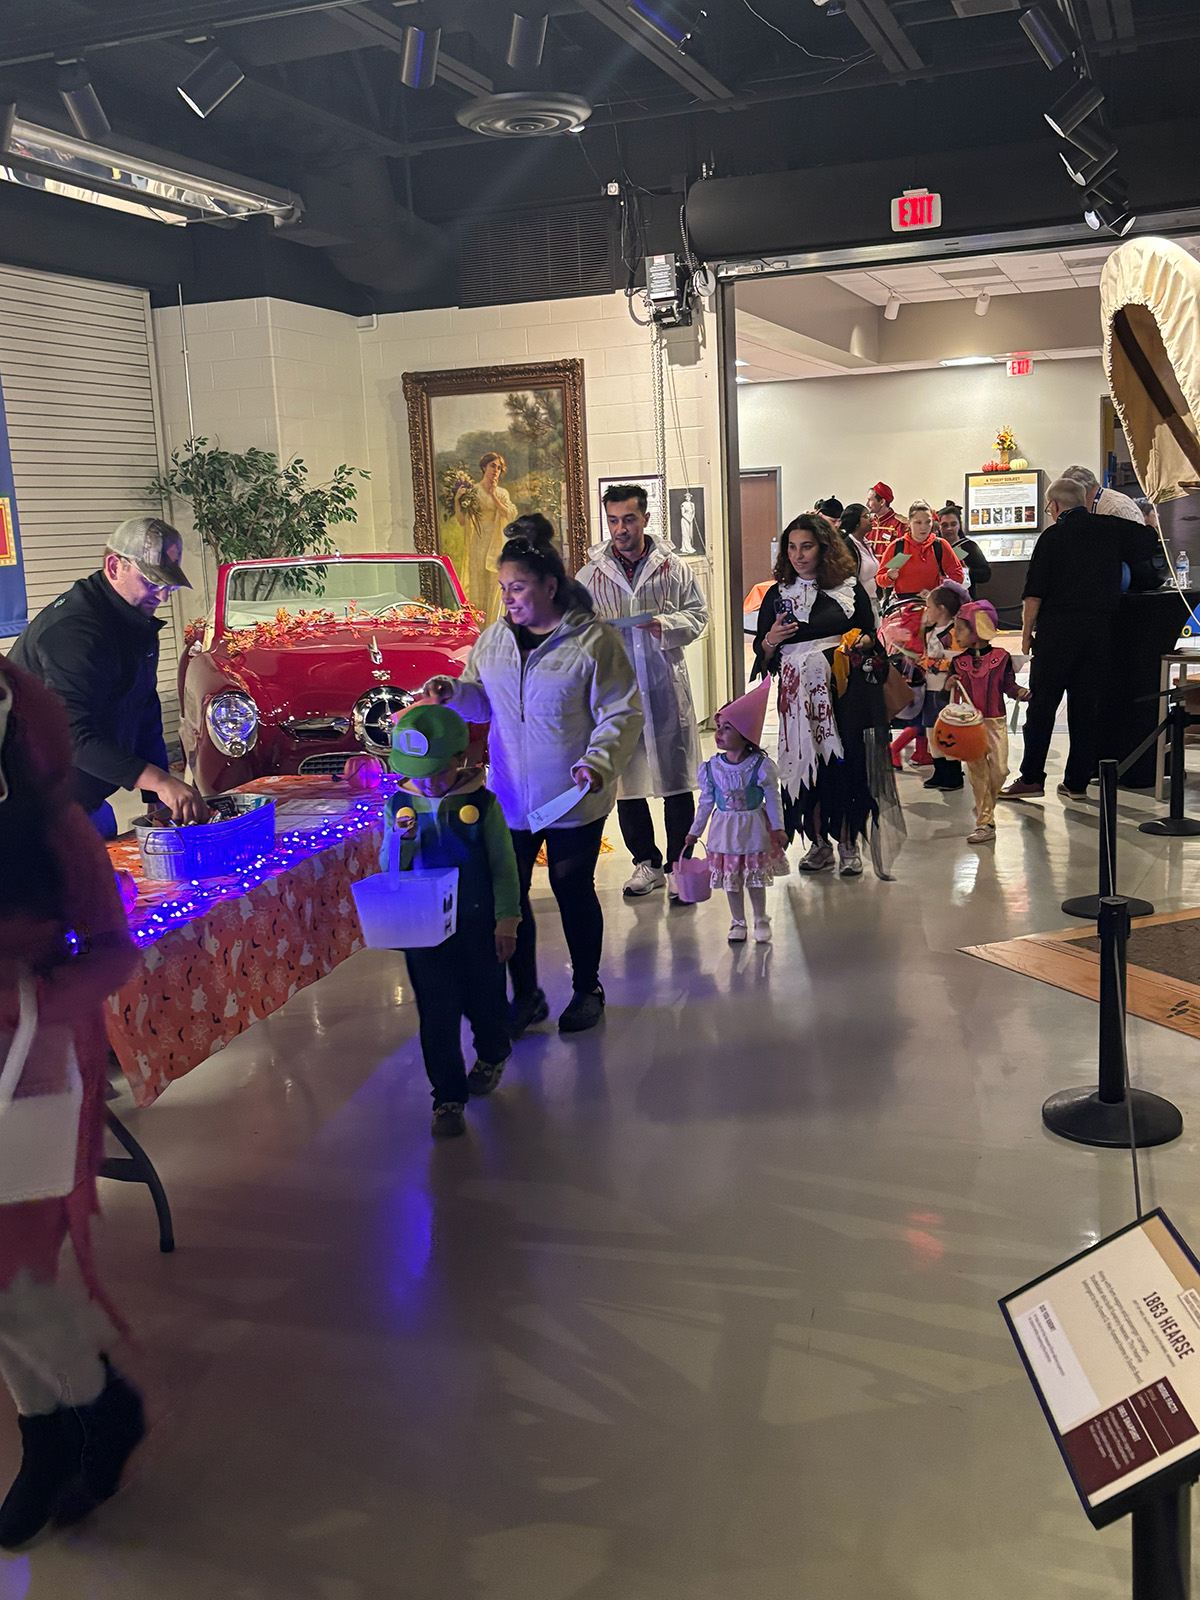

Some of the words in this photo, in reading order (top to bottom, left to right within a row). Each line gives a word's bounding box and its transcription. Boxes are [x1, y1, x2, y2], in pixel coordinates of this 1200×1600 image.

[898, 195, 935, 227] EXIT
[1011, 359, 1030, 375] EXIT
[405, 733, 421, 753] L
[1143, 1291, 1168, 1319] 1863
[1158, 1315, 1195, 1360] HEARSE
